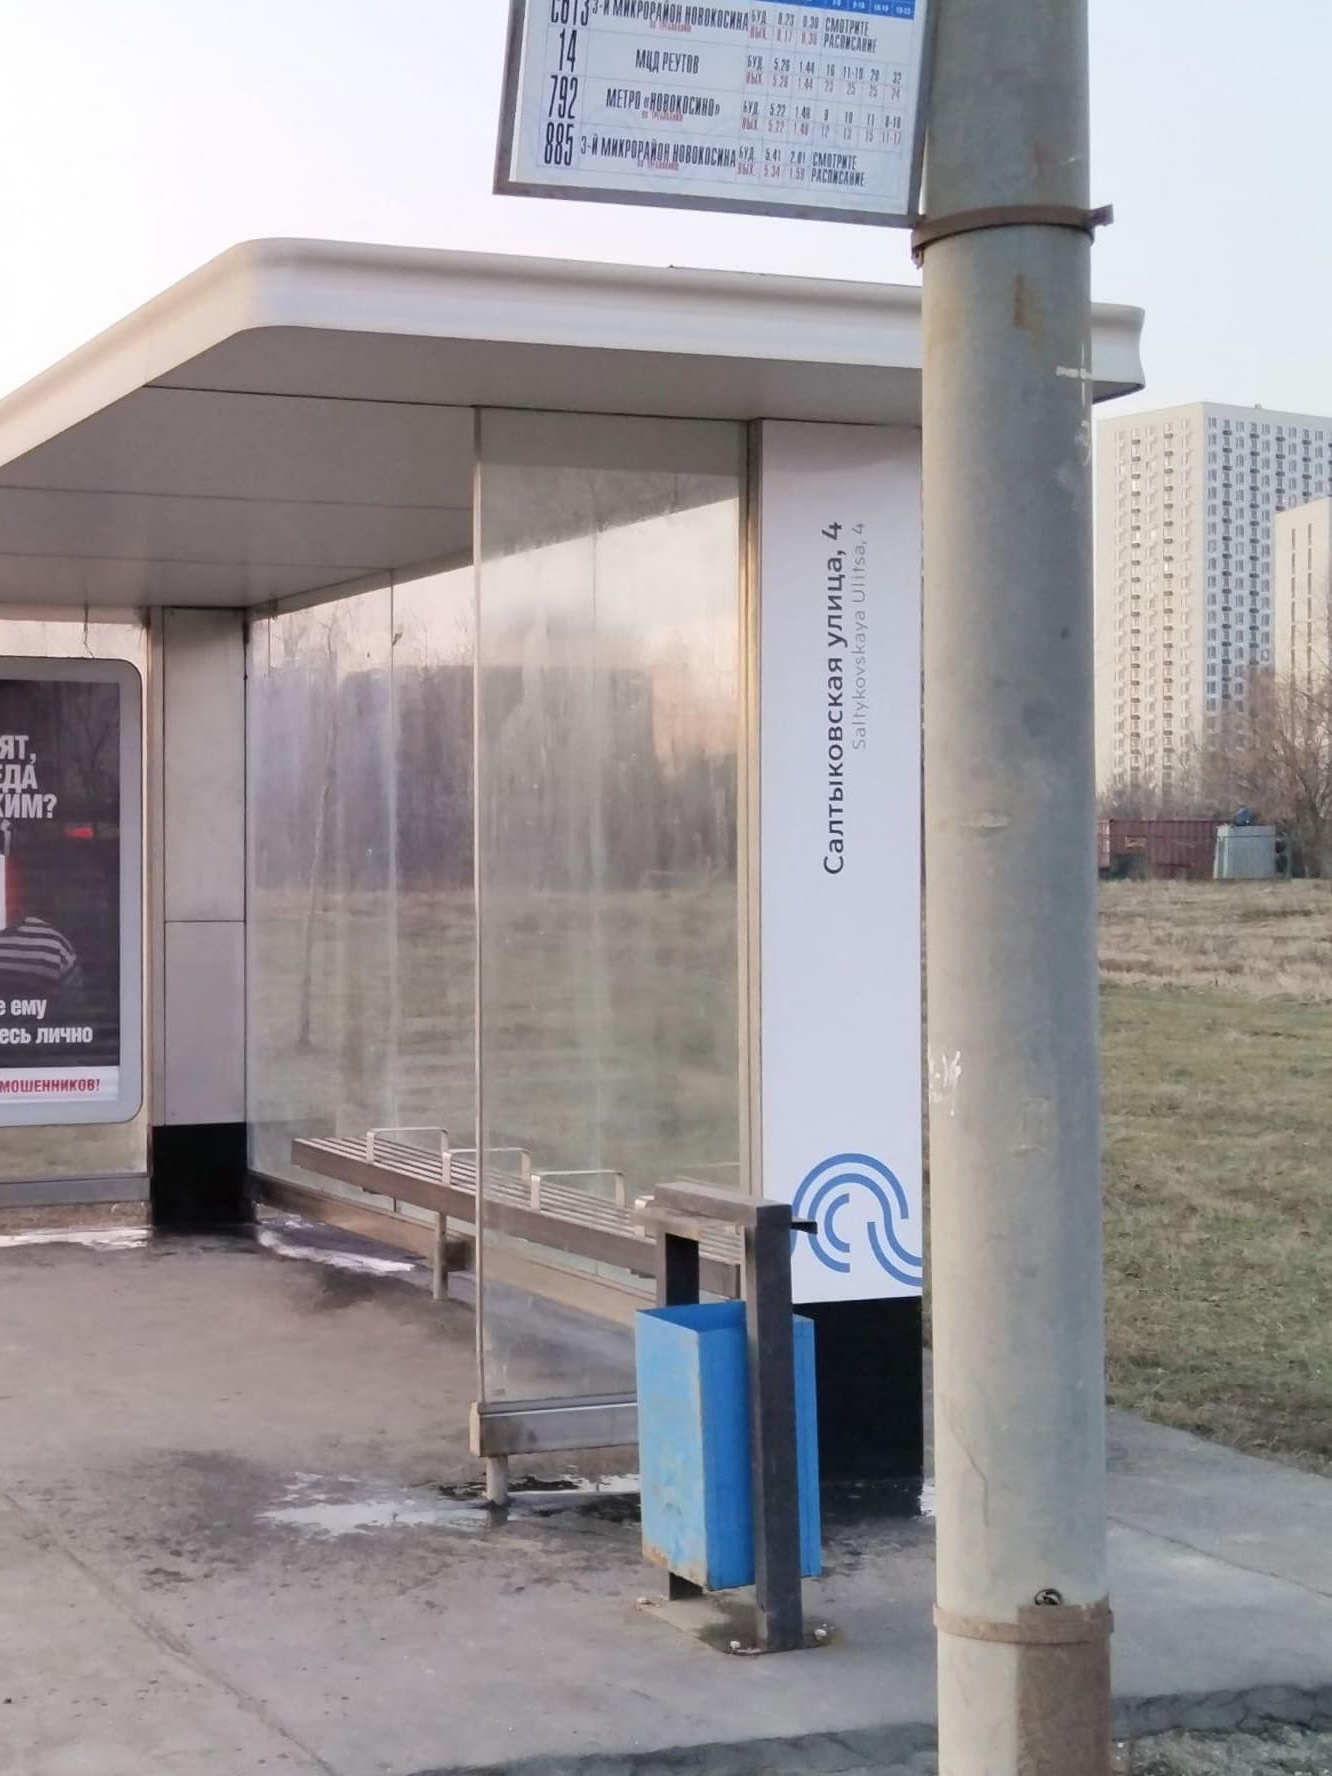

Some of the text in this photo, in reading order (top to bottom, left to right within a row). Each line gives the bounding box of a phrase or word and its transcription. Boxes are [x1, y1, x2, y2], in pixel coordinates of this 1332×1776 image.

[612, 0, 682, 24] МИКРОРАЙОН
[685, 6, 748, 31] НОВОКОСИНА
[825, 16, 868, 36] СМОТРИТЕ
[559, 28, 577, 73] 14
[824, 33, 876, 53] РАСПИСАНИЕ
[635, 50, 699, 74] МЦД РЕУТОВ
[548, 75, 578, 119] 792
[606, 88, 641, 110] МЕТРО
[643, 92, 720, 117] «НОВОКОСИНО»
[544, 121, 575, 166] 885
[581, 135, 599, 156] 3-Й
[601, 137, 669, 162] МИКРОРАЙОН
[672, 143, 736, 167] НОВОКОСИНА
[812, 152, 857, 170] СМОТРИТЕ
[811, 168, 865, 187] РАСПИСАНИЕ
[852, 523, 868, 750] Saltykovskaya Ulitsa, 4
[821, 521, 848, 875] Салтыковская улица, 4
[10, 998, 47, 1020] ему
[35, 1027, 93, 1045] лично
